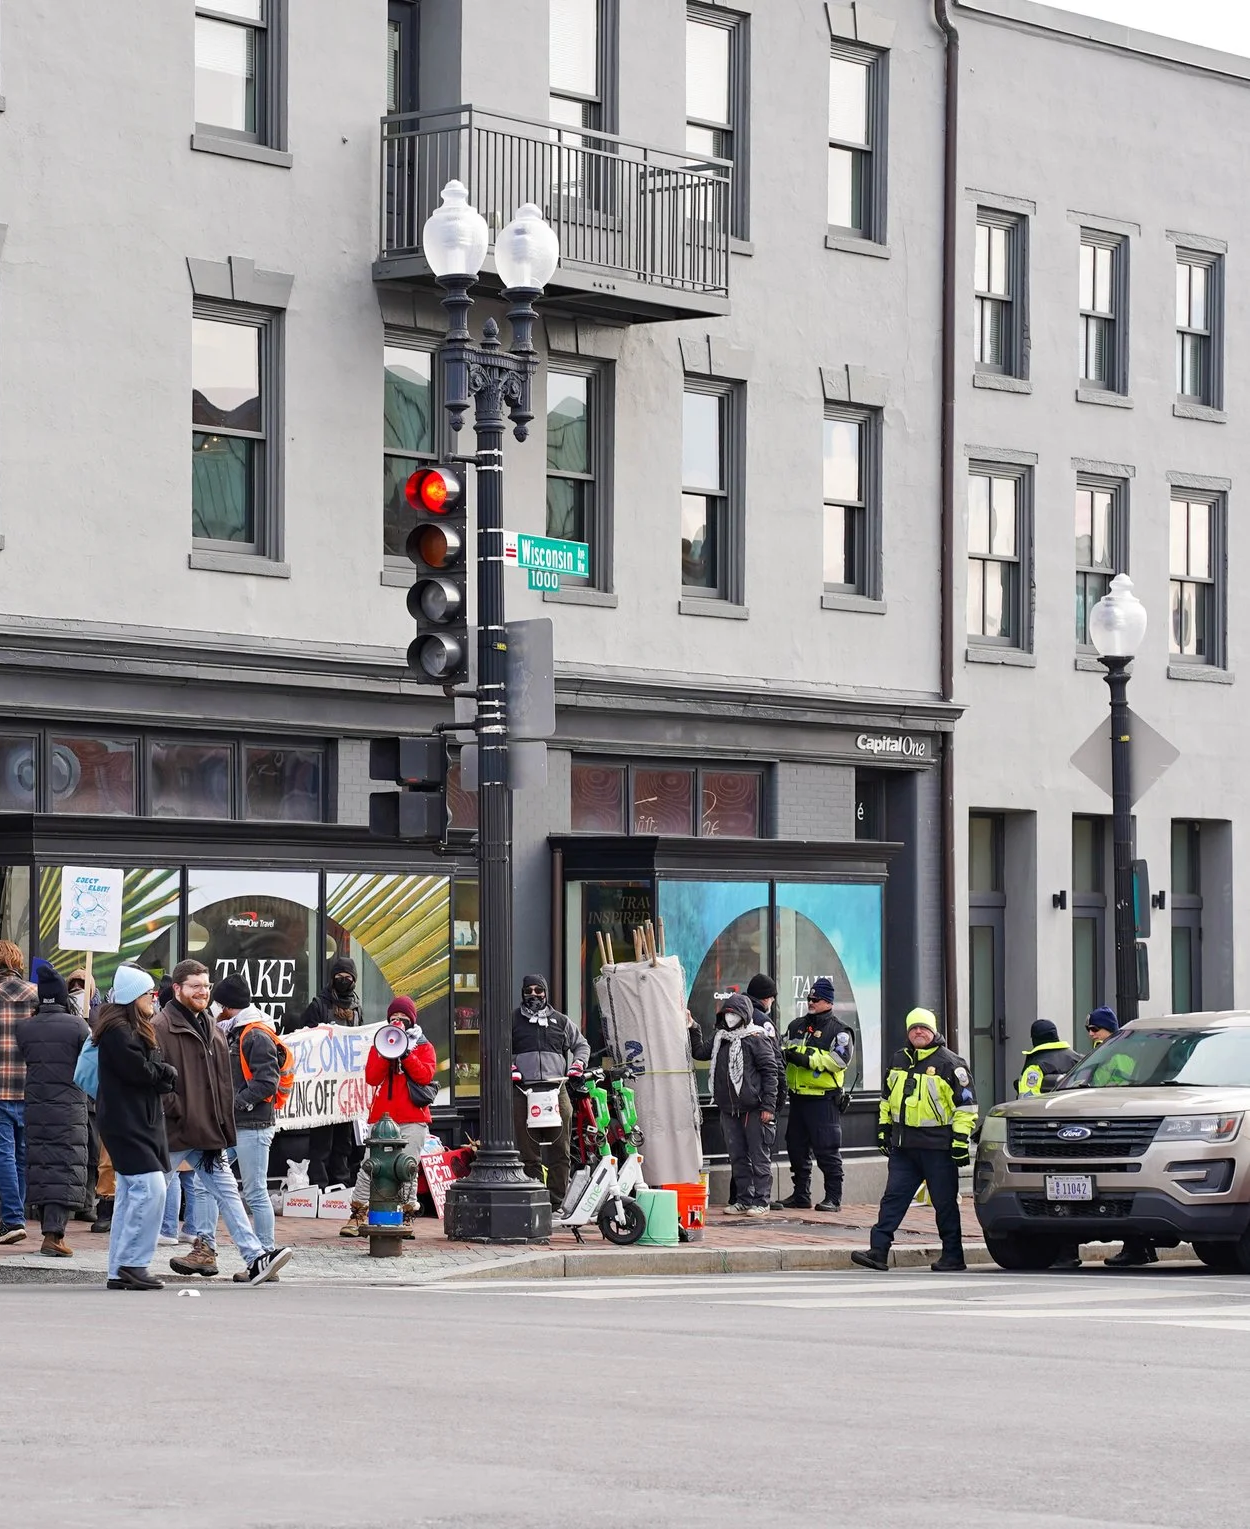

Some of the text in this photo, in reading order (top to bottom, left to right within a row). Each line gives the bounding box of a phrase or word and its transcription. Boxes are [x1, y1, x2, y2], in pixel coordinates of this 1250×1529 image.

[521, 539, 573, 570] Wisconsin
[531, 570, 558, 589] 1000
[260, 919, 275, 928] Travel
[315, 1079, 337, 1115] OFF
[424, 1155, 444, 1166] FROM
[426, 1165, 443, 1183] DC
[1063, 1183, 1086, 1194] 11042
[581, 1185, 602, 1212] Lime
